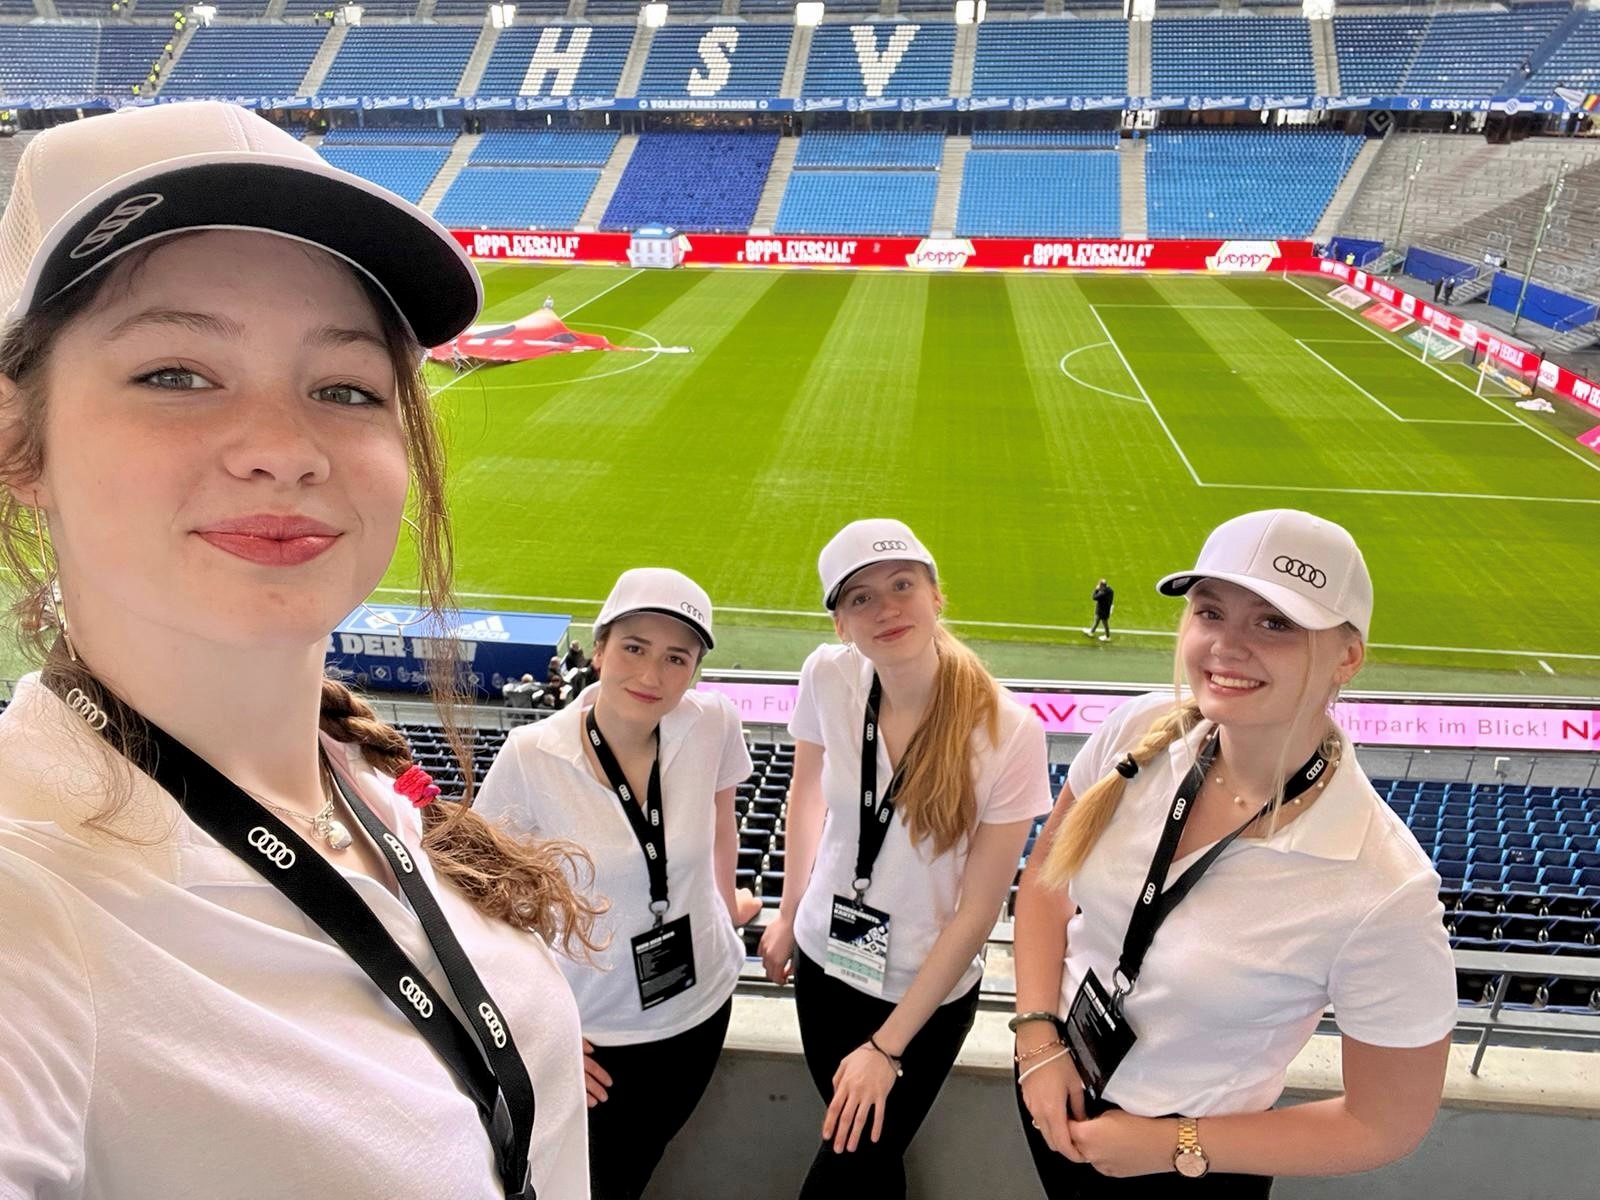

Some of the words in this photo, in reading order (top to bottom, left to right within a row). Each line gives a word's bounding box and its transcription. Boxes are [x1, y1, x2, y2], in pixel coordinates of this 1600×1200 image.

[650, 99, 758, 109] VOLKSPARKSTADION
[1480, 99, 1491, 110] N
[340, 633, 406, 657] DER
[1438, 717, 1466, 735] im
[1478, 719, 1547, 737] Blick!
[1562, 719, 1600, 741] N
